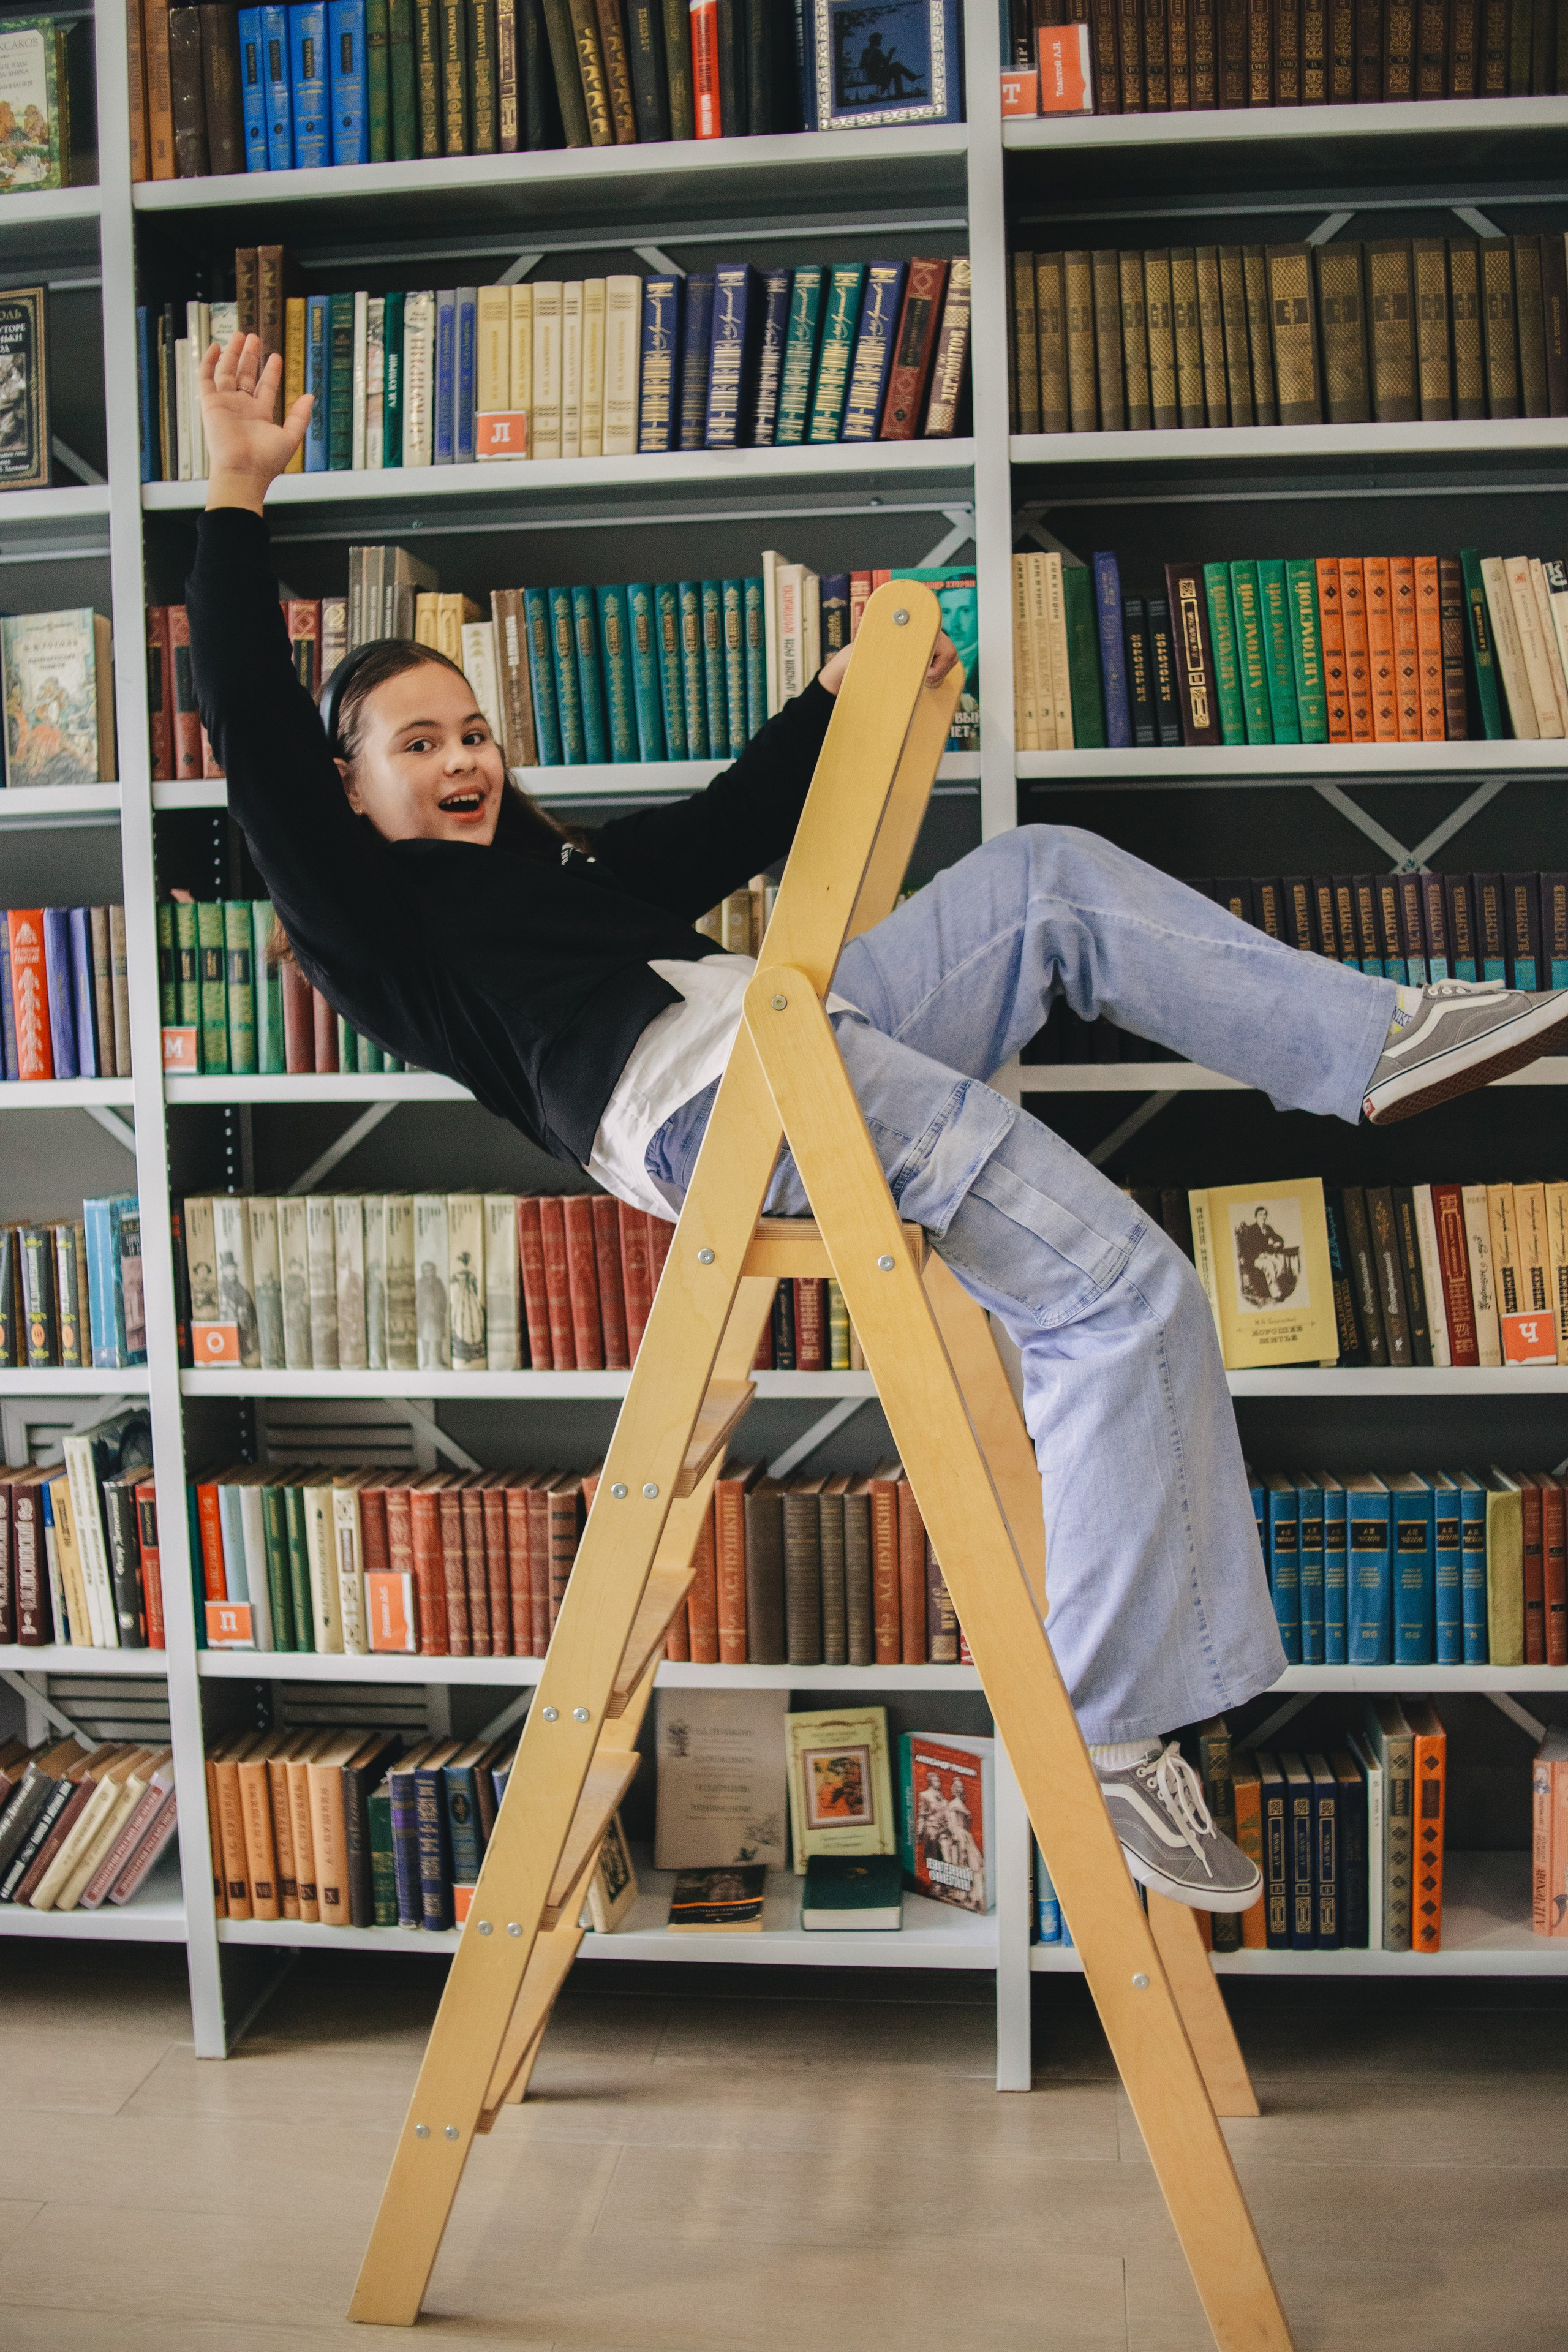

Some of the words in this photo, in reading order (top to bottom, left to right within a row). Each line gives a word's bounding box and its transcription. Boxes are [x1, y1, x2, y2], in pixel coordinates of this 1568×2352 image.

[940, 330, 966, 404] ЛЕРМОНТОВ
[490, 423, 511, 443] Л
[164, 1039, 183, 1058] М
[1251, 1324, 1303, 1336] ХОРОШЕЕ
[1518, 1322, 1539, 1342] Ч
[206, 1332, 224, 1354] О
[724, 1494, 737, 1572] ПУШКИН
[876, 1493, 891, 1570] ПУШКИН
[220, 1611, 238, 1631] П
[926, 1858, 973, 1880] ЕВГЕНИЙ
[929, 1869, 971, 1891] ОНЕГИН
